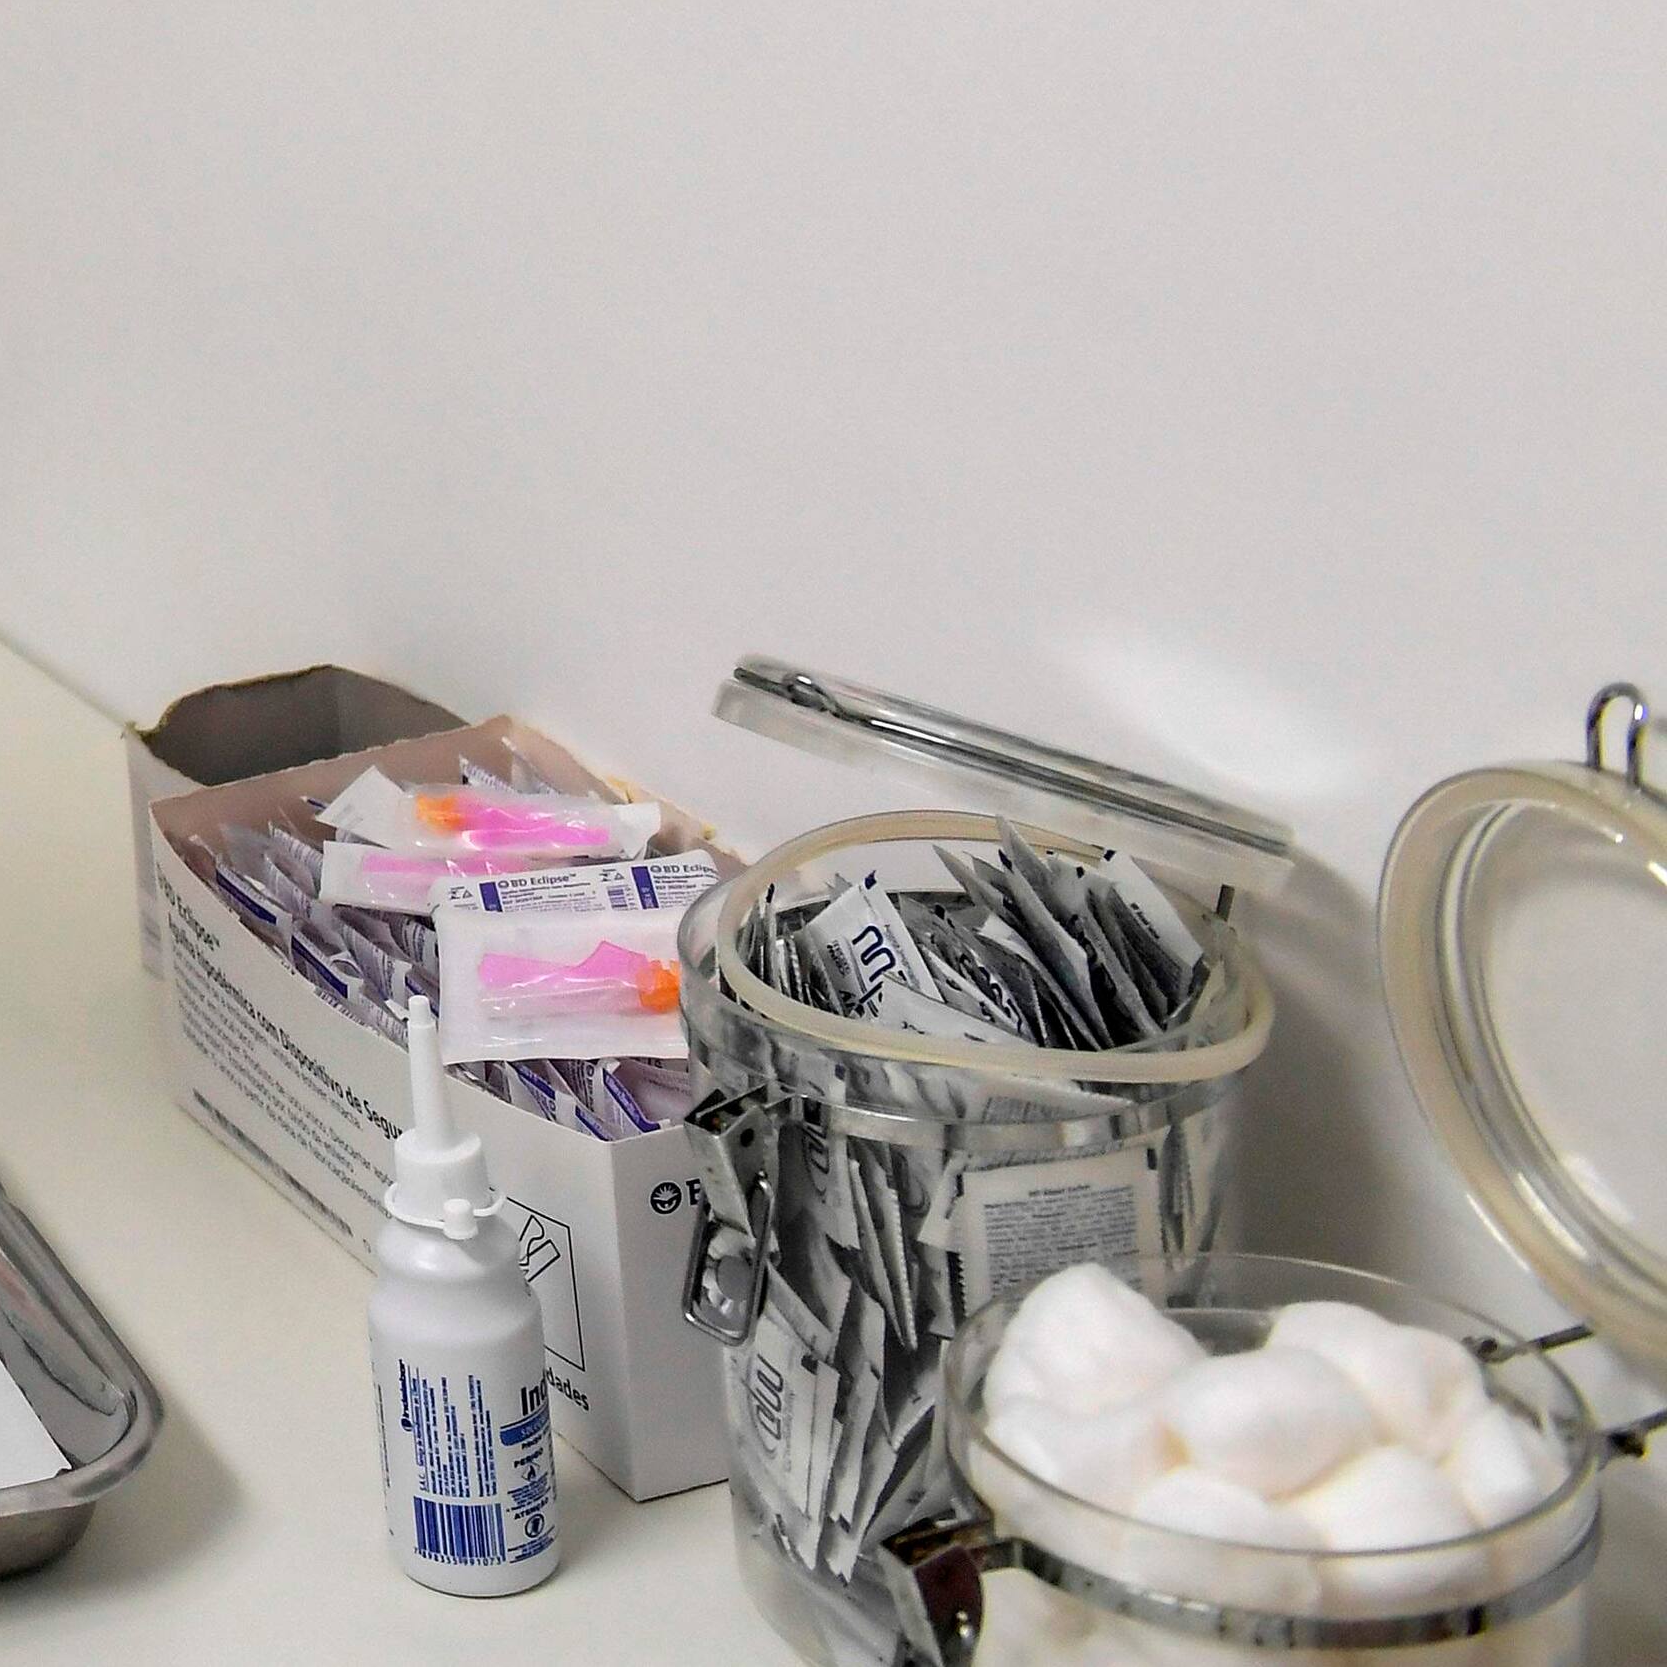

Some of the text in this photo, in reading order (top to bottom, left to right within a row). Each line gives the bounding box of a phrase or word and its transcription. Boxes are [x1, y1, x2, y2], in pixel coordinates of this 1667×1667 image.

[510, 879, 529, 888] BD
[279, 1028, 344, 1098] Dispositivo
[346, 1086, 363, 1114] de
[546, 1367, 589, 1411] dades
